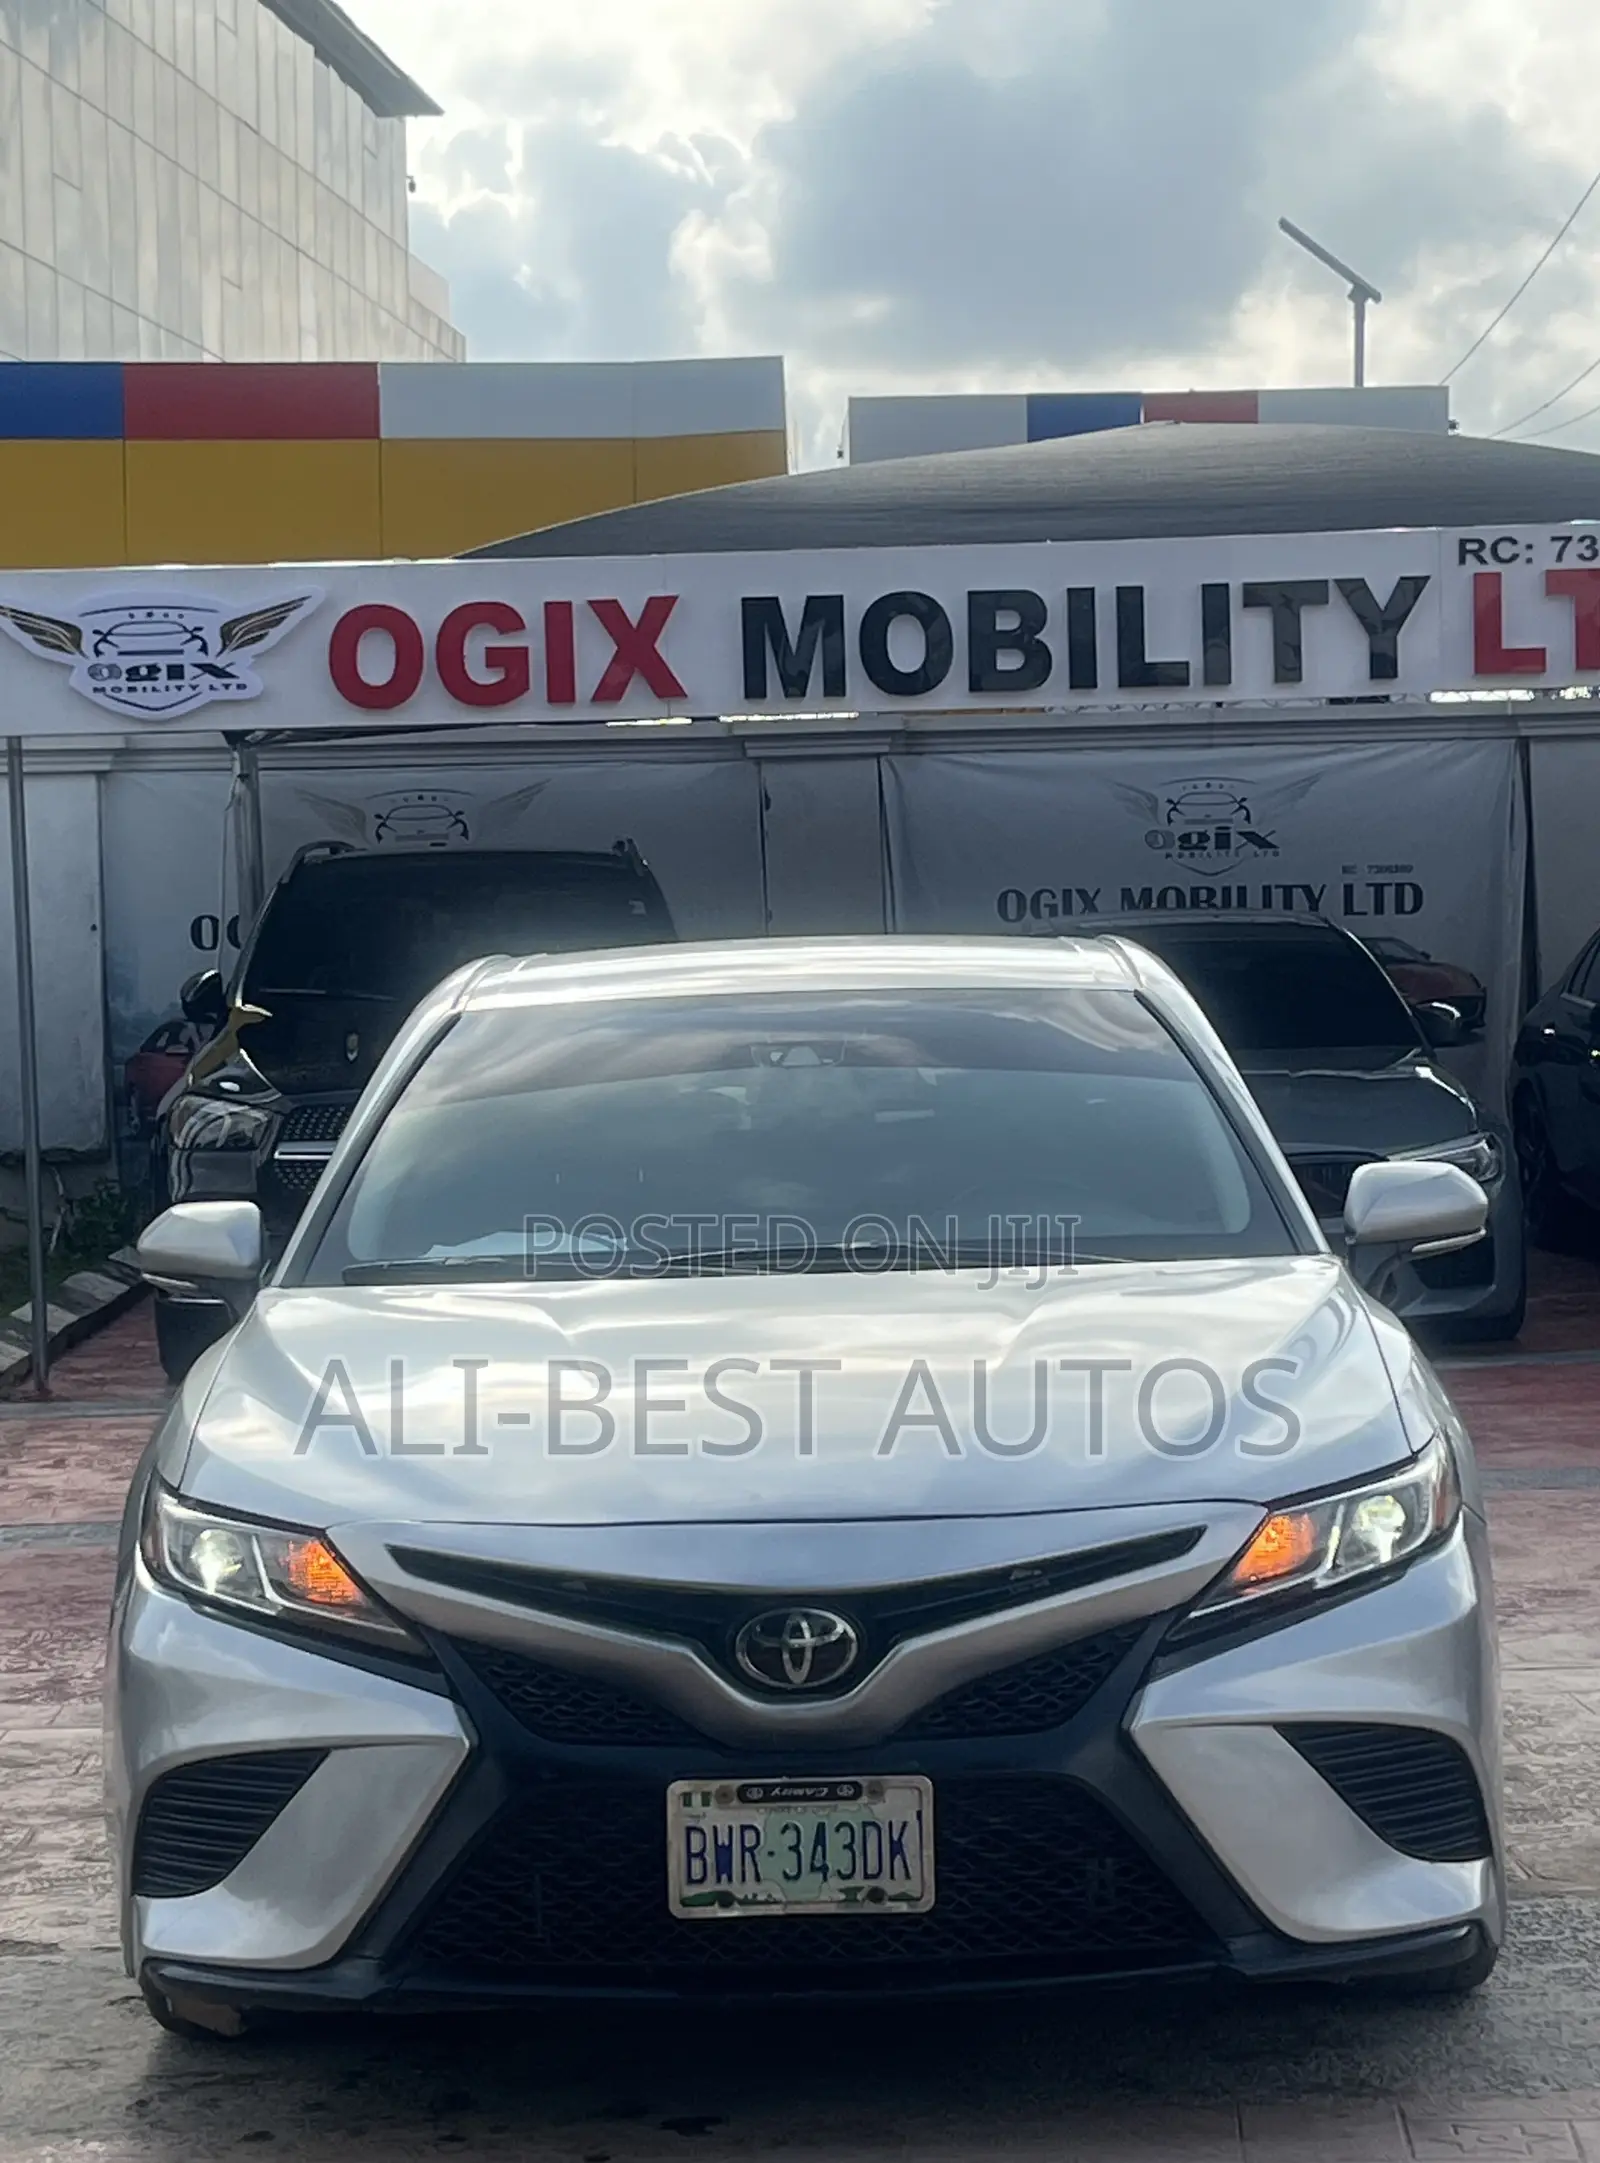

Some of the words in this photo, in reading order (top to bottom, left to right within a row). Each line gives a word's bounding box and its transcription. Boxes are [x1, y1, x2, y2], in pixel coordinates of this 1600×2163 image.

[1457, 536, 1534, 566] RC:
[1549, 534, 1600, 564] 73
[328, 594, 688, 710] OGIX
[741, 575, 1431, 701] MOBILITY
[92, 683, 201, 694] MOBILITY
[208, 682, 248, 692] LTD
[996, 887, 1101, 924] OGIX
[1121, 883, 1327, 914] MOBILITY
[1342, 881, 1424, 917] LTD
[684, 1819, 912, 1886] BWR-343DK
